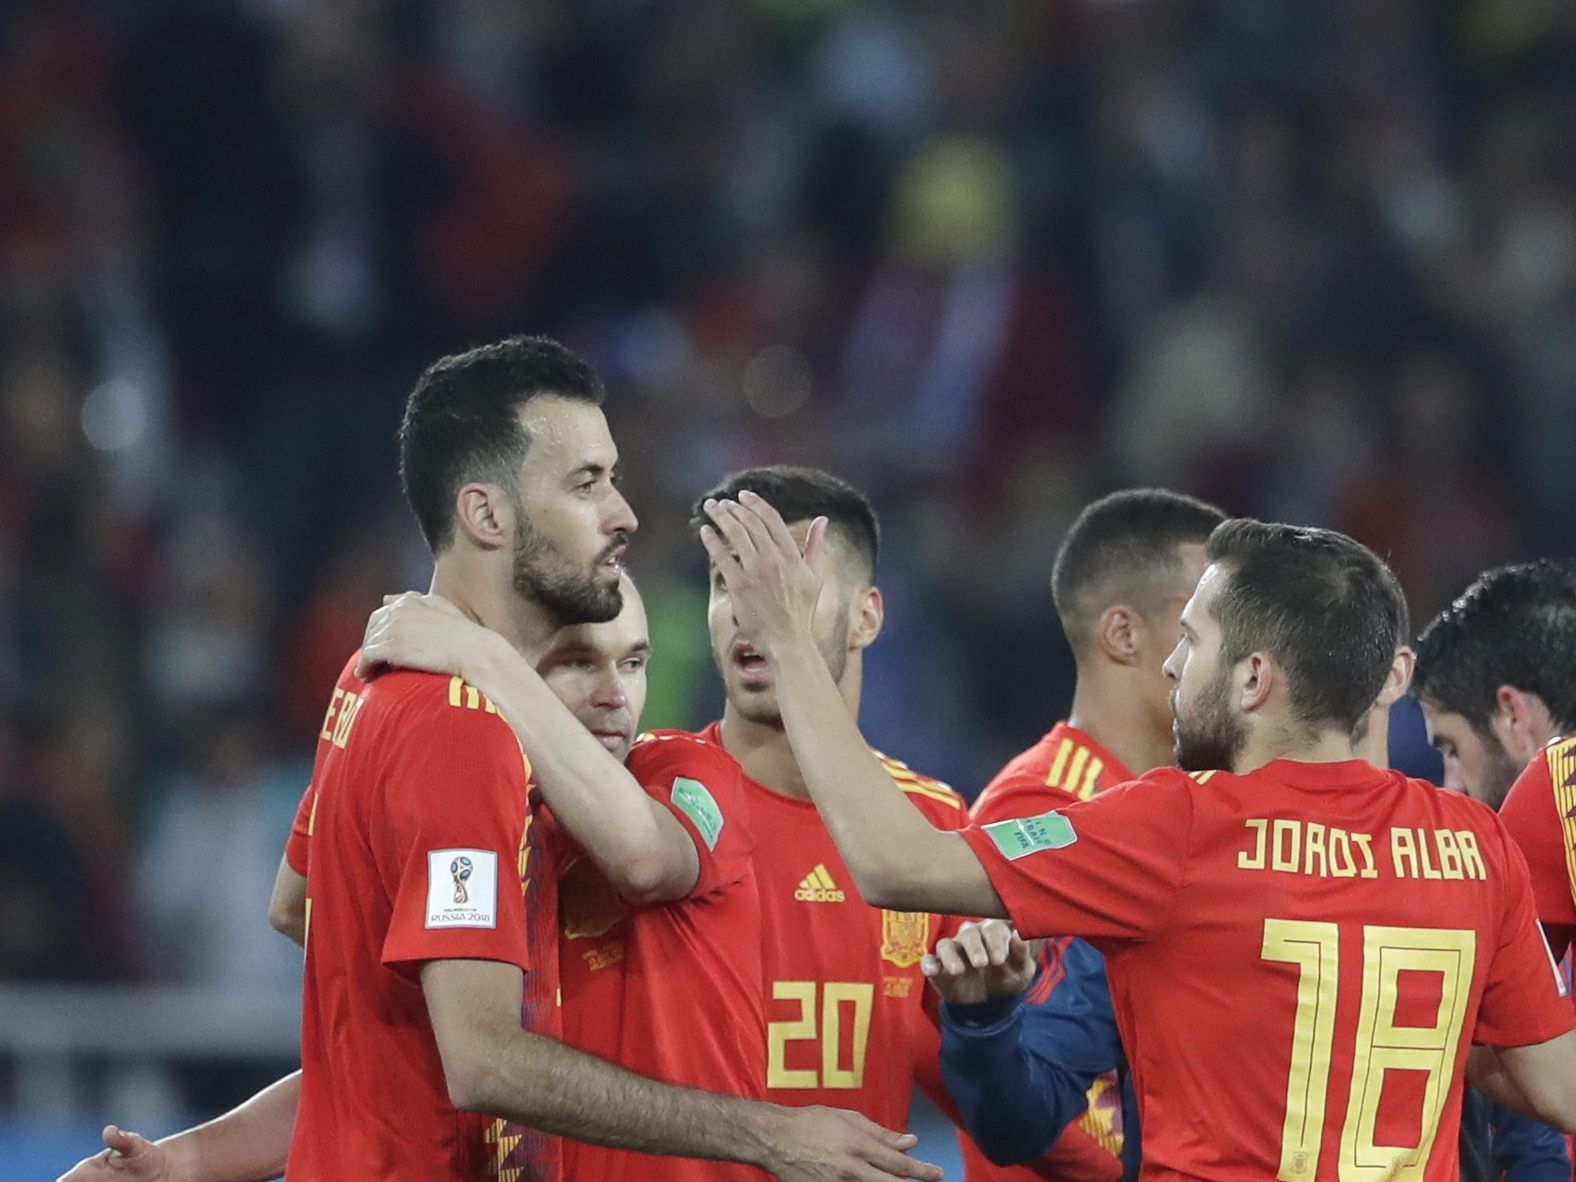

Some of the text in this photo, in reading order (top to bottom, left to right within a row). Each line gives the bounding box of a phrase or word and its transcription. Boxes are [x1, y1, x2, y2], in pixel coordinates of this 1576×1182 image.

[1237, 818, 1487, 881] JORDI ALBA
[794, 888, 846, 903] adidas
[767, 980, 875, 1089] 20
